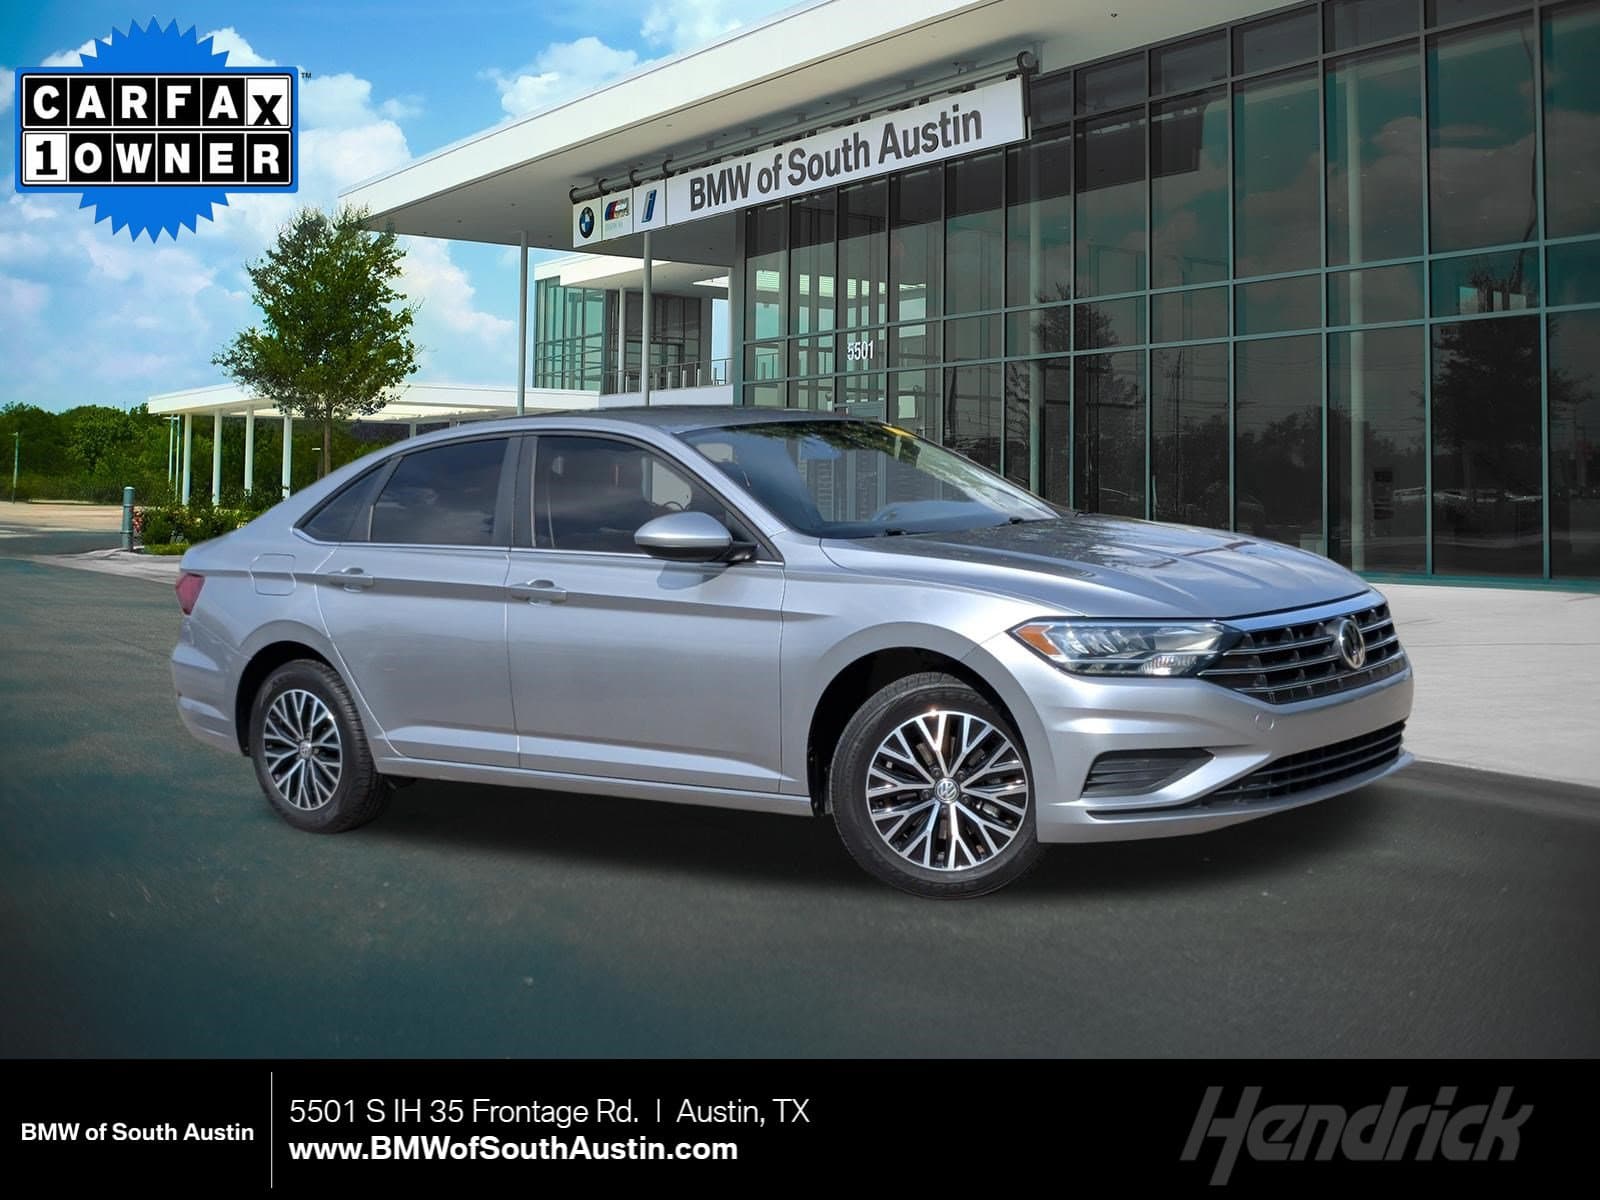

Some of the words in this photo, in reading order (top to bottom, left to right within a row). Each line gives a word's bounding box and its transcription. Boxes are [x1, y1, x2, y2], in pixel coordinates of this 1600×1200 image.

[690, 162, 752, 212] BMW
[757, 153, 783, 194] of
[787, 131, 870, 186] South
[878, 104, 982, 164] Austin
[847, 340, 874, 360] 5501
